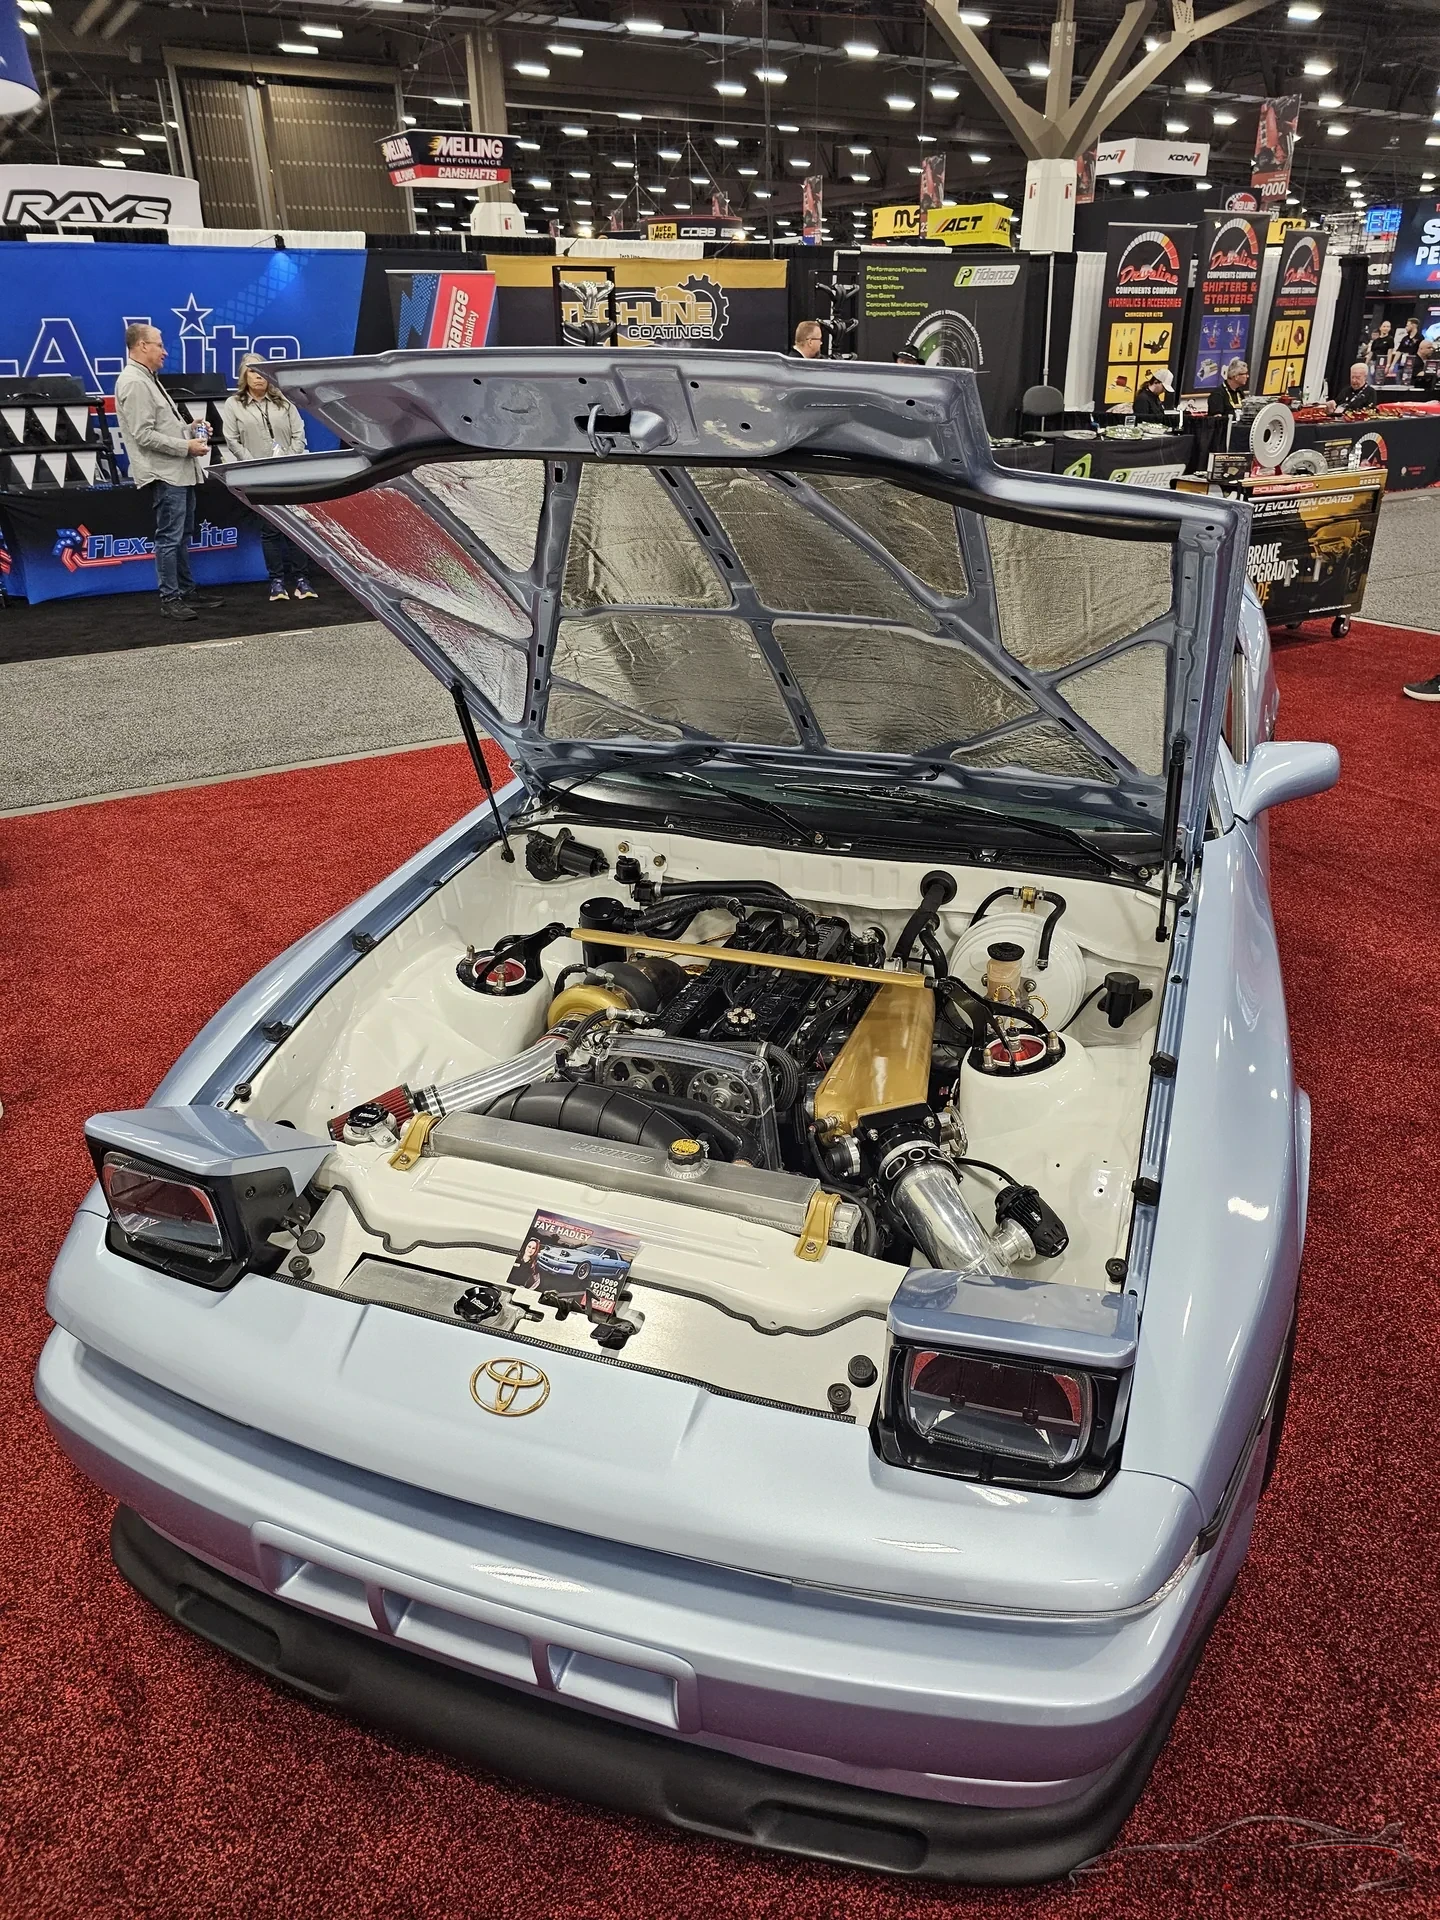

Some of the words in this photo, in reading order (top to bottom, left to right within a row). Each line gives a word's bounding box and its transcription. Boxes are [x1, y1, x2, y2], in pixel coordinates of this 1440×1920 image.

[1054, 36, 1060, 47] 5
[1066, 36, 1072, 46] 5
[385, 137, 412, 162] MELLING
[434, 137, 504, 159] MELLING
[434, 157, 502, 166] PERFORMANCE
[1167, 153, 1198, 165] KONI
[437, 168, 498, 180] CAMSHAFTS
[3, 189, 172, 225] RAYS
[941, 215, 984, 232] ACT
[680, 227, 717, 237] COBB
[973, 268, 1017, 280] fidanza
[1206, 271, 1236, 279] COMPONENTS
[1236, 271, 1257, 279] COMPANY
[1115, 286, 1151, 294] COMPONENTS
[1152, 286, 1178, 295] COMPANY
[1202, 282, 1248, 292] SHIFTERS
[1250, 282, 1257, 292] &
[891, 301, 929, 309] Manufacturing
[1108, 298, 1141, 308] HYDRAULICS
[1147, 298, 1182, 308] ACCESSORIES
[1203, 294, 1254, 304] STARTERS
[628, 325, 713, 339] COATINGS
[1129, 470, 1181, 486] fidanza
[1265, 498, 1318, 512] EVOLUTION
[1317, 494, 1355, 506] COATED
[1247, 542, 1282, 566] BRAKE
[534, 1220, 556, 1232] FAYE
[556, 1226, 591, 1242] HADLEY
[590, 1280, 618, 1295] TOYOTA
[601, 1277, 619, 1288] 1989
[592, 1288, 616, 1301] SUPRA
